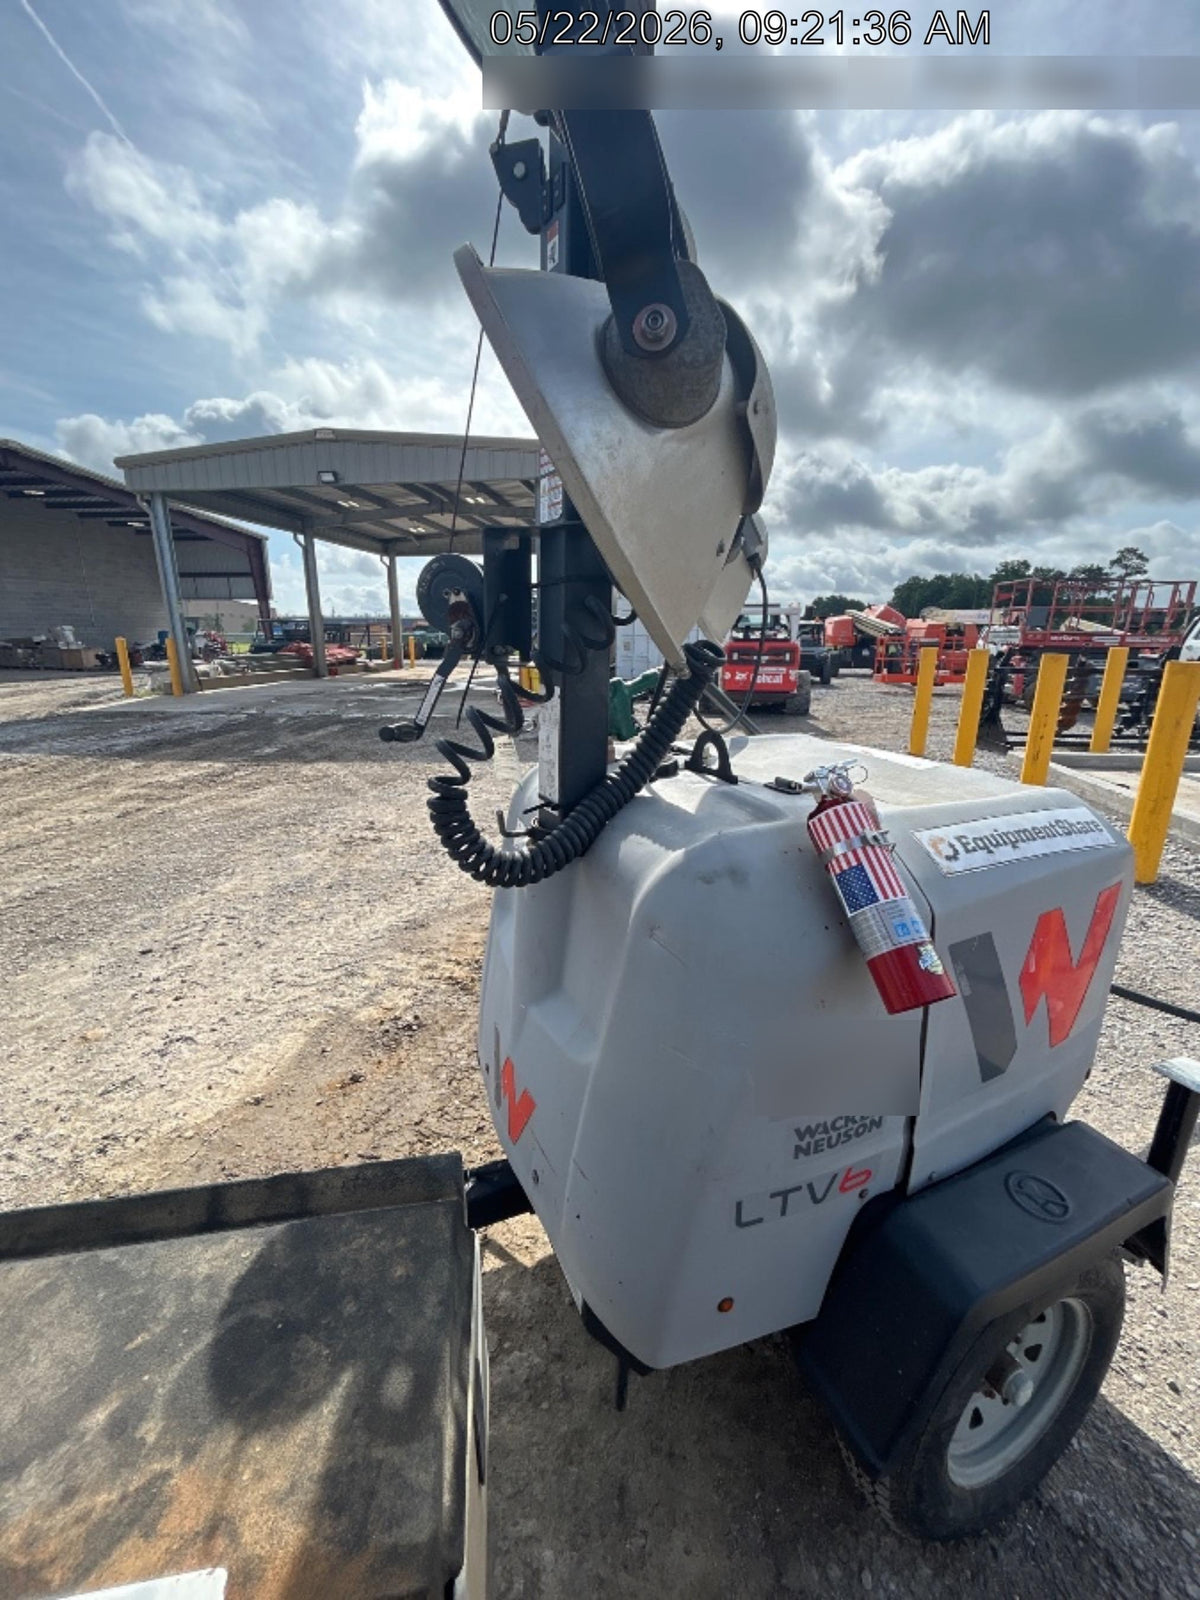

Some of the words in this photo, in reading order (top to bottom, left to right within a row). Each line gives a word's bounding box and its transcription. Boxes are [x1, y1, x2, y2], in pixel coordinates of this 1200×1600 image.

[958, 819, 1103, 854] EquipmentShare
[793, 1116, 883, 1159] NEUSON
[794, 1116, 876, 1141] WACK
[735, 1167, 872, 1228] LTV6
